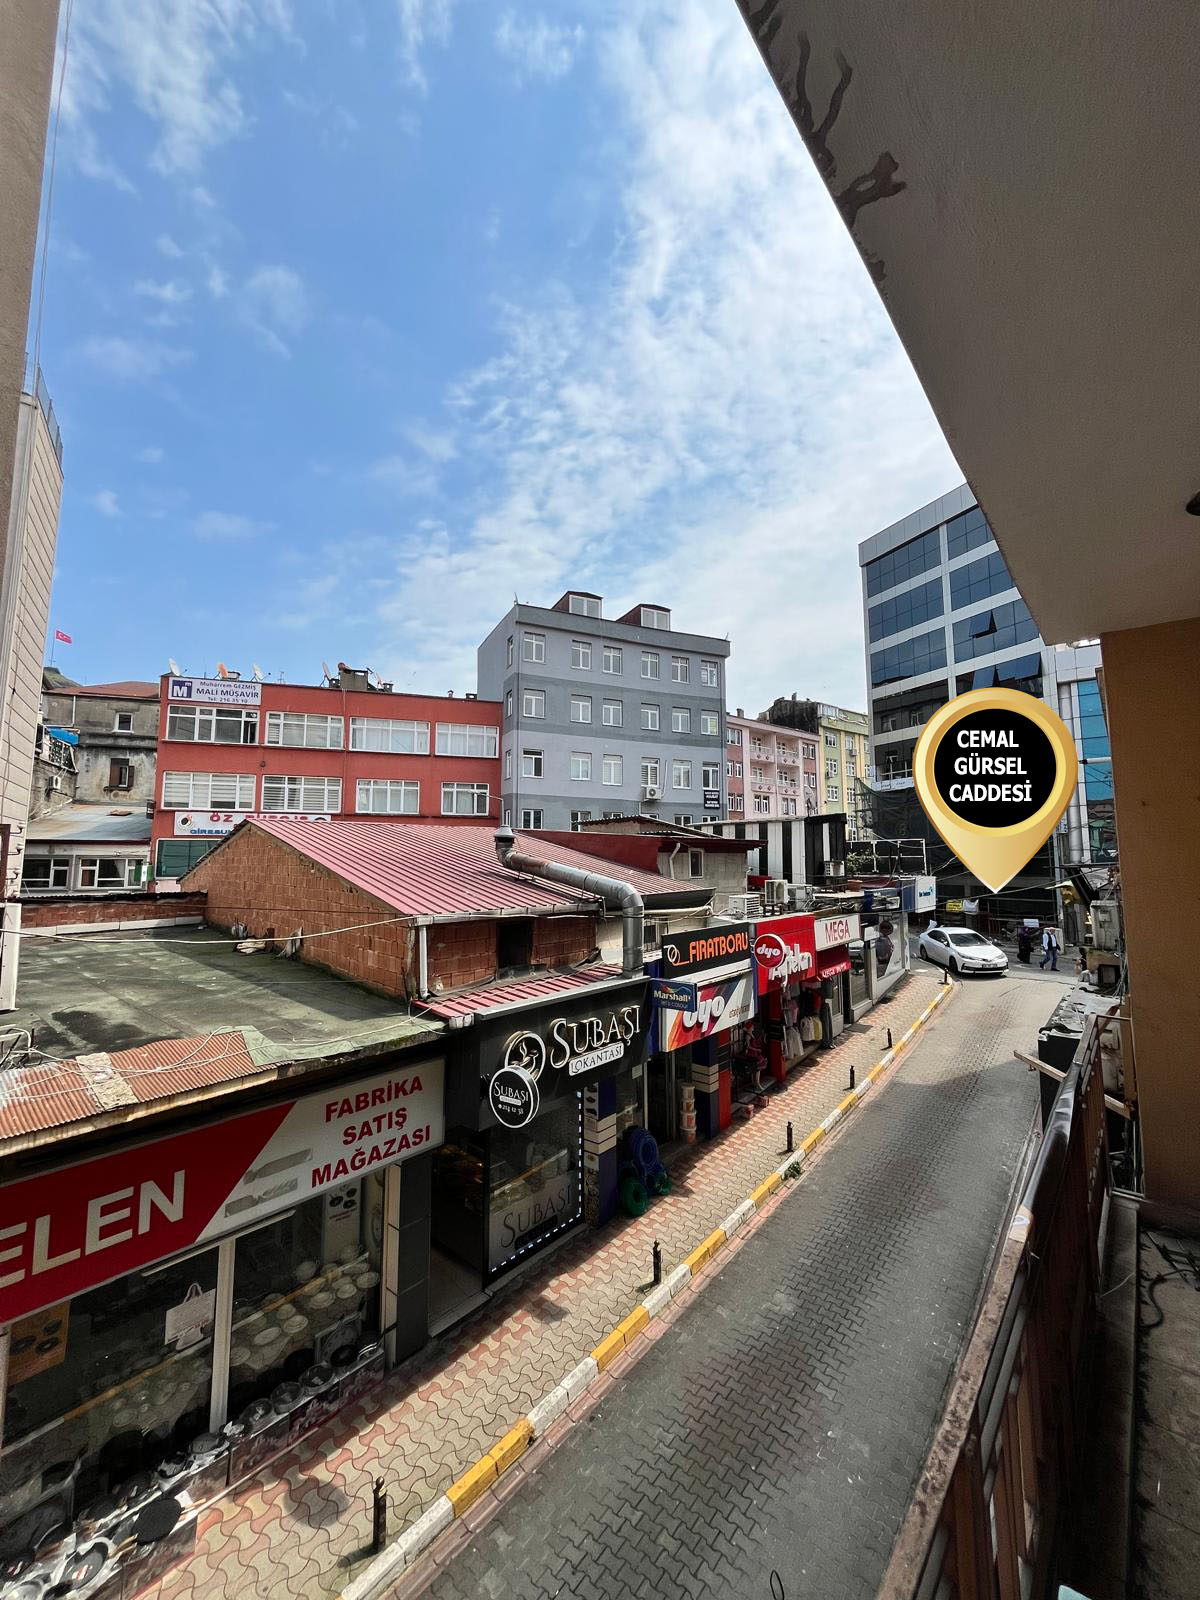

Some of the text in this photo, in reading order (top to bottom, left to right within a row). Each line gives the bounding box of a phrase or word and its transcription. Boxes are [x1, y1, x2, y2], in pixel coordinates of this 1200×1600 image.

[196, 688, 259, 699] MALİ MÜŞAVİR
[210, 812, 233, 822] ÖZ
[825, 919, 851, 943] MEGA
[689, 931, 749, 963] FIRATBORU
[756, 943, 781, 959] dyo
[653, 990, 688, 1002] Marshall
[550, 1005, 641, 1069] SUBAŞI
[571, 1044, 623, 1073] LOKANTASI
[325, 1075, 423, 1123] FABRİKA
[493, 1081, 529, 1103] SUBAŞI
[342, 1106, 408, 1146] SATIŞ
[311, 1124, 431, 1189] MAĞAZASI
[501, 1184, 573, 1249] SUBAŞI
